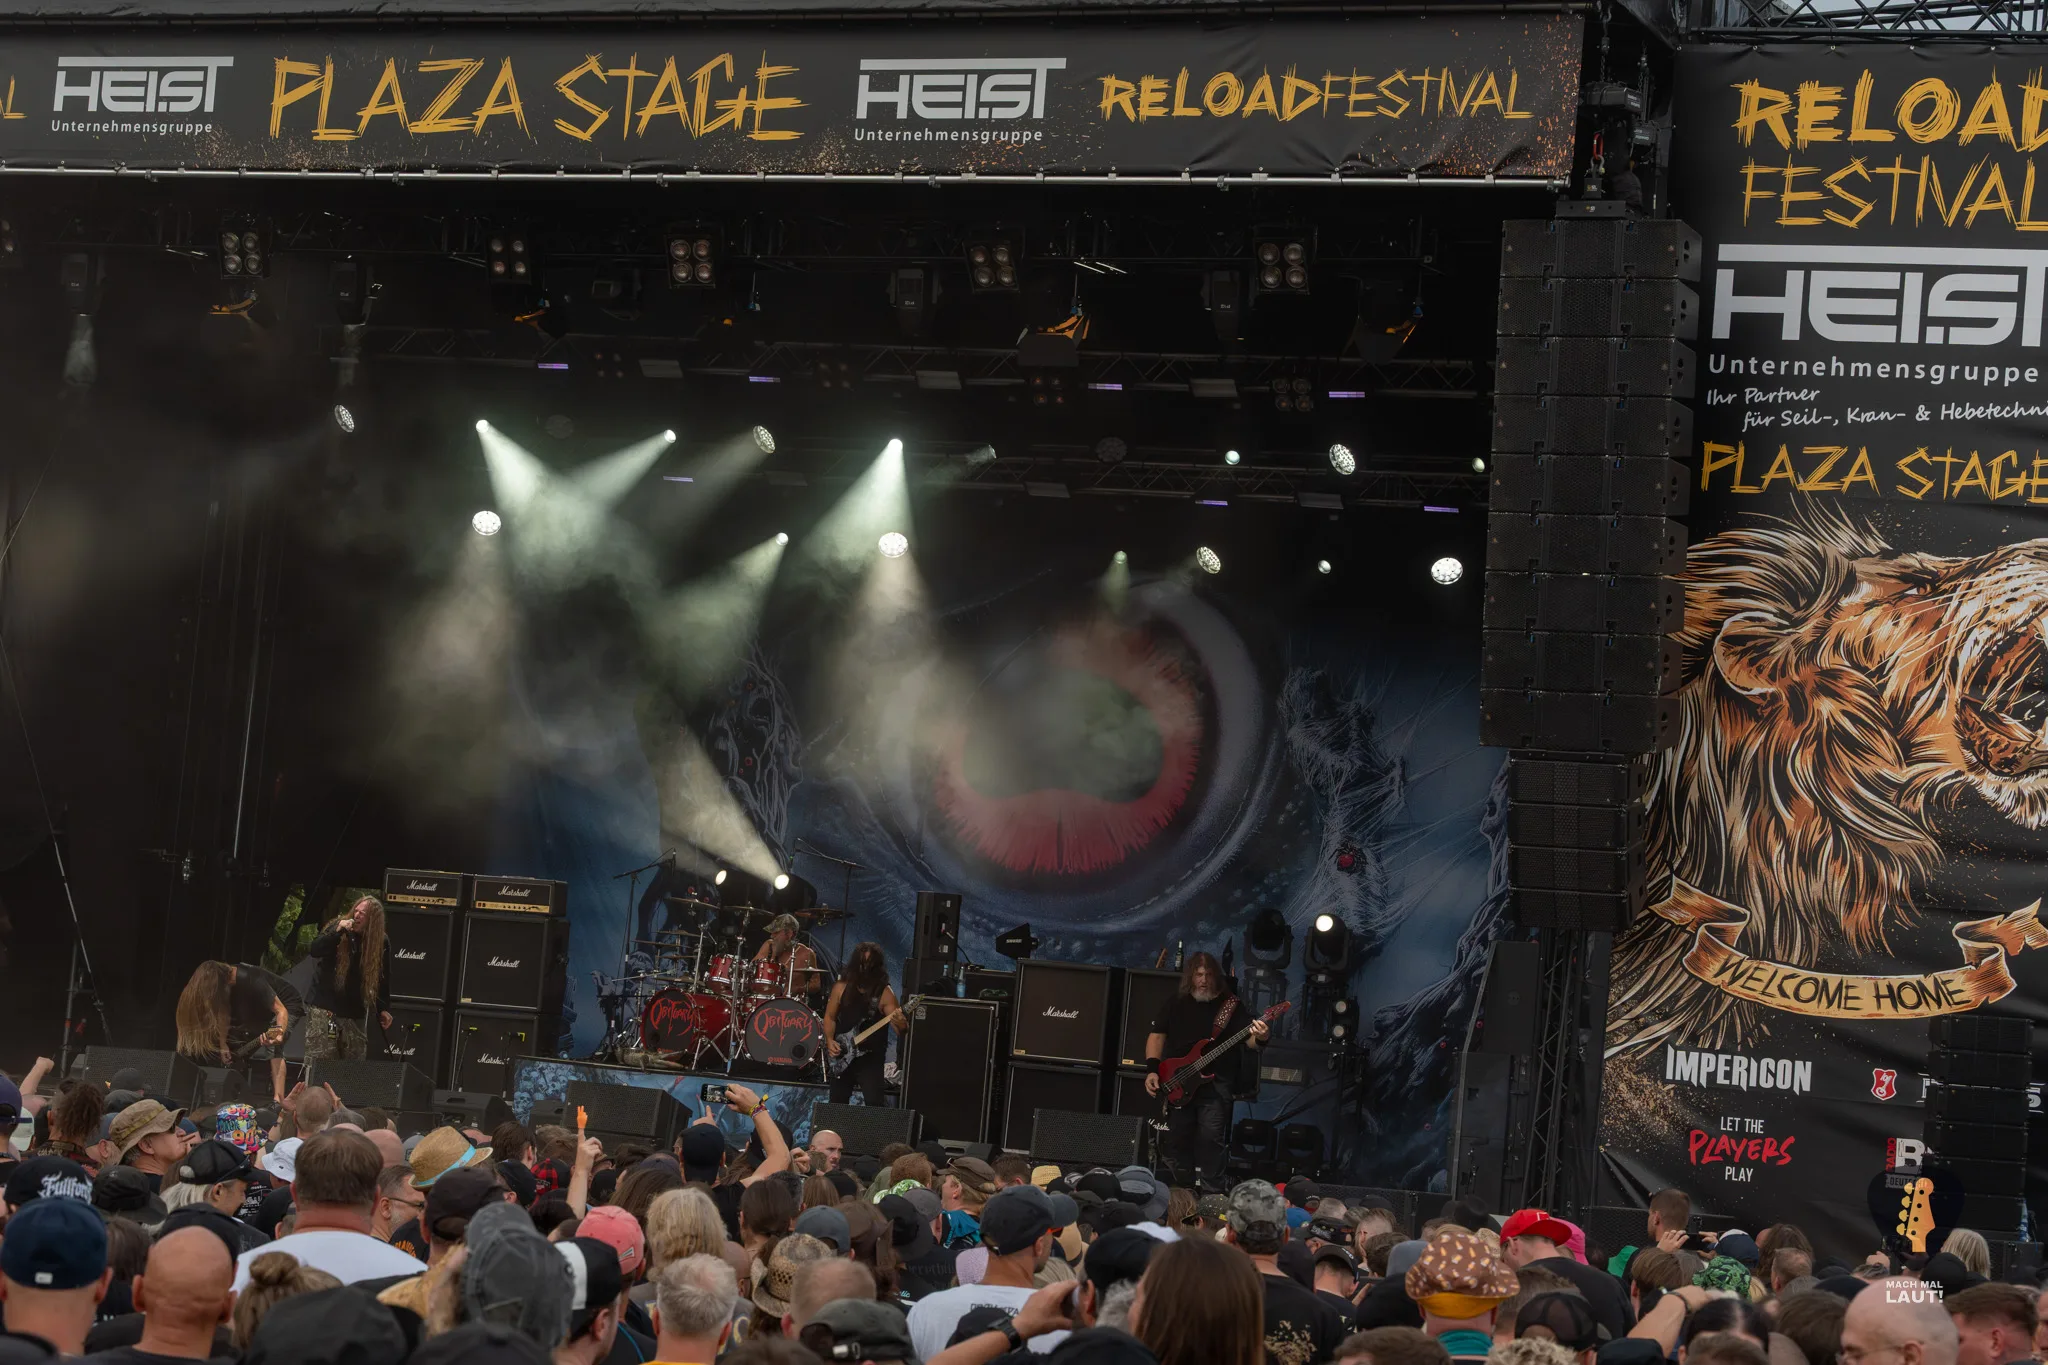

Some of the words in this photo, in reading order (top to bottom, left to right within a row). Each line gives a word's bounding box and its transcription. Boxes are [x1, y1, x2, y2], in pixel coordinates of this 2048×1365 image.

[53, 56, 234, 113] HEIST
[269, 55, 531, 141] PLAZA
[553, 50, 803, 142] STAGE
[856, 57, 1067, 120] HEIST
[51, 118, 213, 136] Unternehmensgruppe
[854, 127, 1043, 146] Unternehmensgruppe
[1740, 153, 2048, 231] FESTIVAL
[1711, 243, 2048, 347] HEIST
[1708, 354, 2040, 387] Unternehmensgruppe
[1707, 389, 1738, 406] Ihr
[1744, 387, 1821, 405] Partner
[1742, 410, 1776, 432] für
[1781, 407, 1839, 427] Seil-,
[1847, 406, 1907, 425] Kran-
[1915, 405, 1932, 422] &
[1700, 440, 1882, 499] PLAZA
[1895, 445, 2048, 504] STAGE
[406, 880, 438, 892] Marshall
[498, 885, 531, 898] Marshall
[394, 948, 426, 960] Marshall
[487, 956, 520, 969] Marshall
[1711, 954, 1864, 1011] WELCOME
[1873, 973, 1974, 1013] HOME
[1043, 1006, 1079, 1019] Marshall
[1665, 1044, 1813, 1096] IMPERICON
[1720, 1116, 1741, 1131] LET
[1744, 1118, 1765, 1134] THE
[1688, 1129, 1796, 1166] PLAYERS
[1725, 1165, 1754, 1182] PLAY
